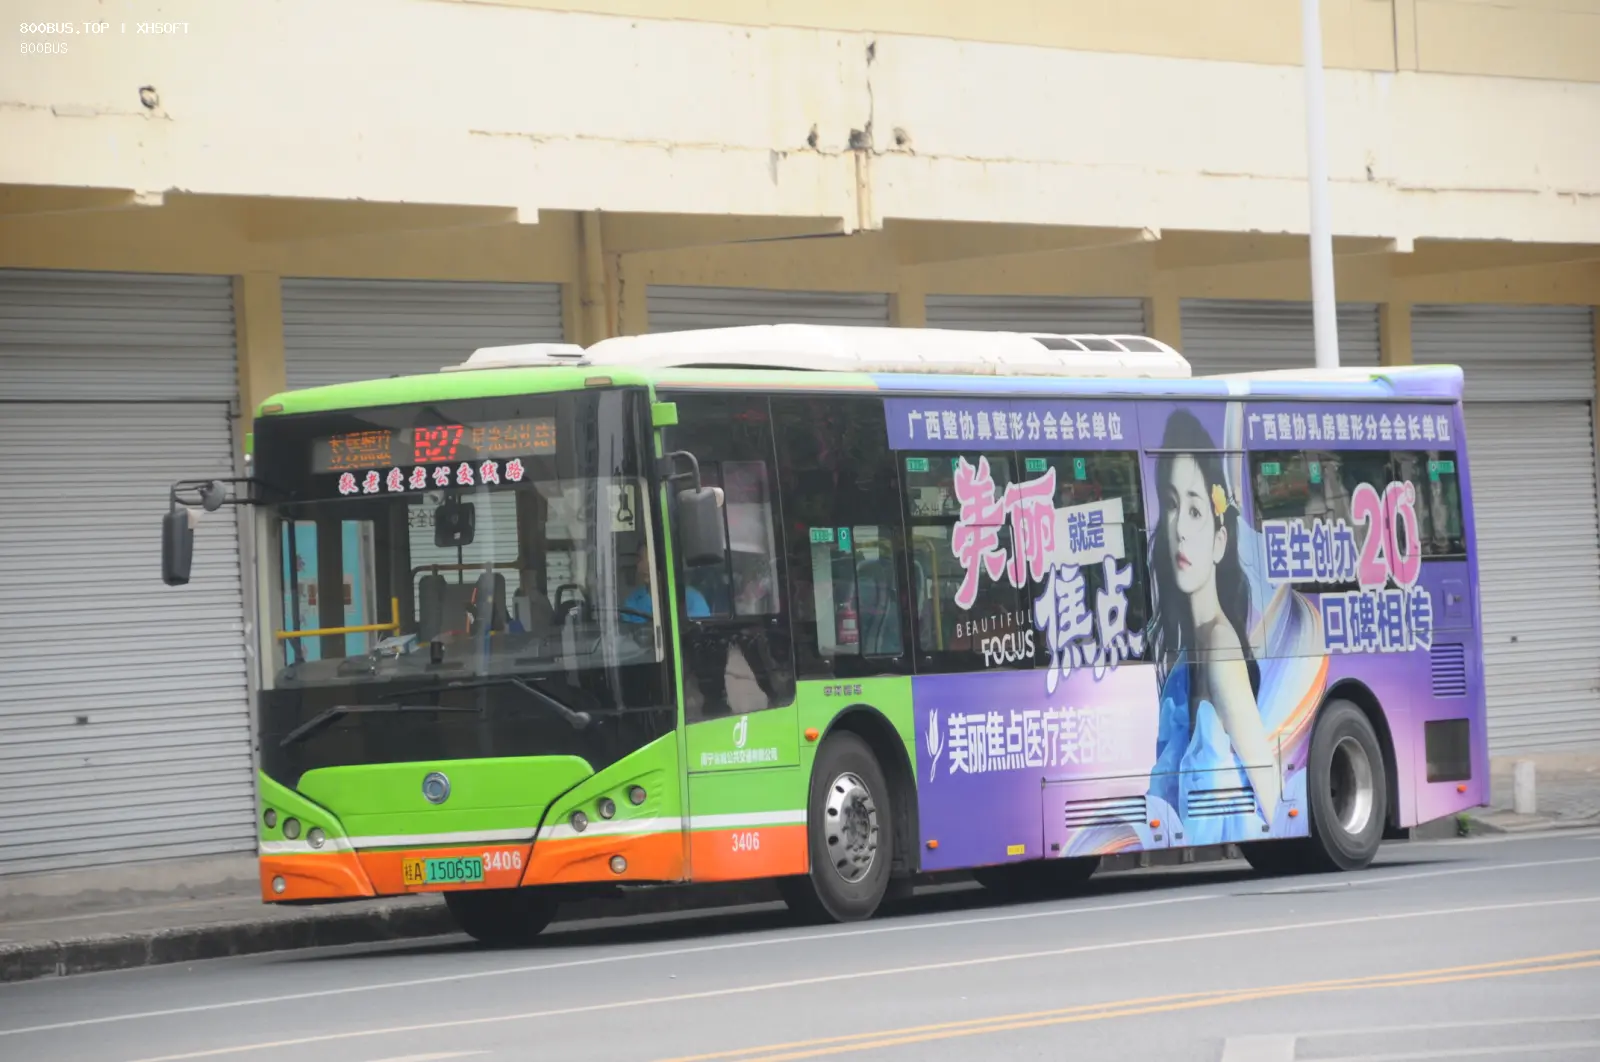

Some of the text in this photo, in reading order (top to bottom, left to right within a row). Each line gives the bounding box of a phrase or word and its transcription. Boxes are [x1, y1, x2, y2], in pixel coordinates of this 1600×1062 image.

[907, 410, 1124, 441] 广西整协鼻整形分会会长单位
[1248, 412, 1451, 442] 广西整协乳房整形分会会长单位
[338, 458, 524, 494] 敬老爱老公交线路
[952, 455, 1057, 610] 美丽
[1067, 509, 1105, 554] 就是
[1262, 518, 1358, 584] 医生创办
[956, 609, 1034, 638] BEAUTIFUL
[1034, 554, 1145, 695] 焦点
[1320, 586, 1434, 654] 口碑相传
[981, 629, 1036, 668] FOCUS
[947, 705, 1133, 775] 美丽焦点医疗美容医
[483, 850, 522, 871] 3406
[731, 832, 760, 851] 3406
